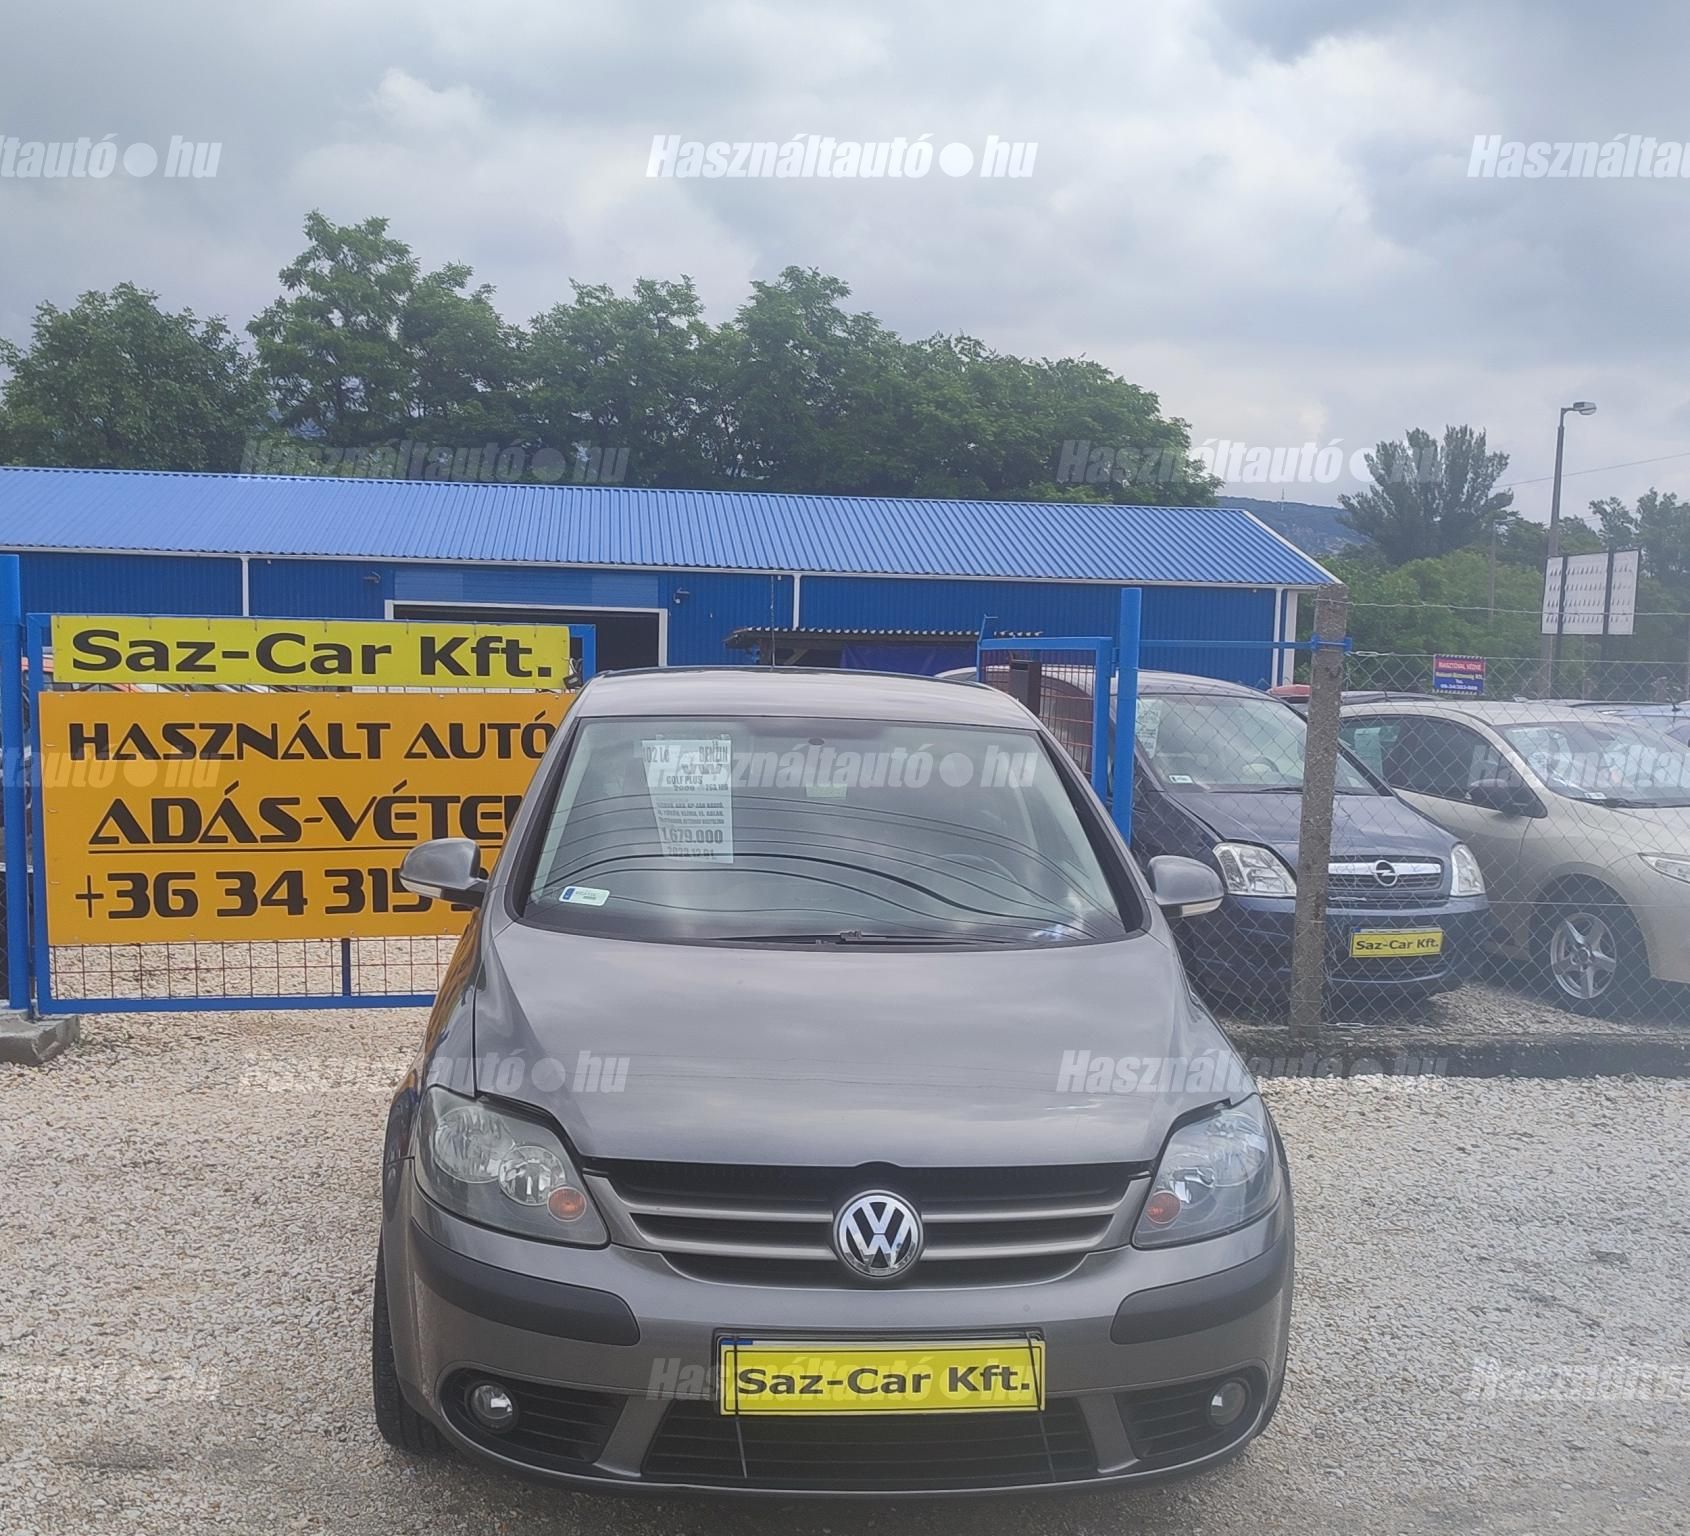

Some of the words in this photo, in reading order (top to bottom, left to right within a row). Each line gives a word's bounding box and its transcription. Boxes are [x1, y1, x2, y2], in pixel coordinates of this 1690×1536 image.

[72, 629, 392, 674] Saz-Car
[420, 635, 553, 677] Kft.
[69, 710, 391, 760] HASZNÁLT
[404, 710, 557, 760] AUTÓ
[685, 775, 704, 785] PLUS
[75, 871, 197, 919] +36
[216, 870, 308, 918] 34
[1355, 939, 1413, 951] Saz-Car
[1416, 937, 1439, 949] Kft.
[738, 1366, 931, 1394] Saz-Car
[948, 1364, 1031, 1392] Kft.
